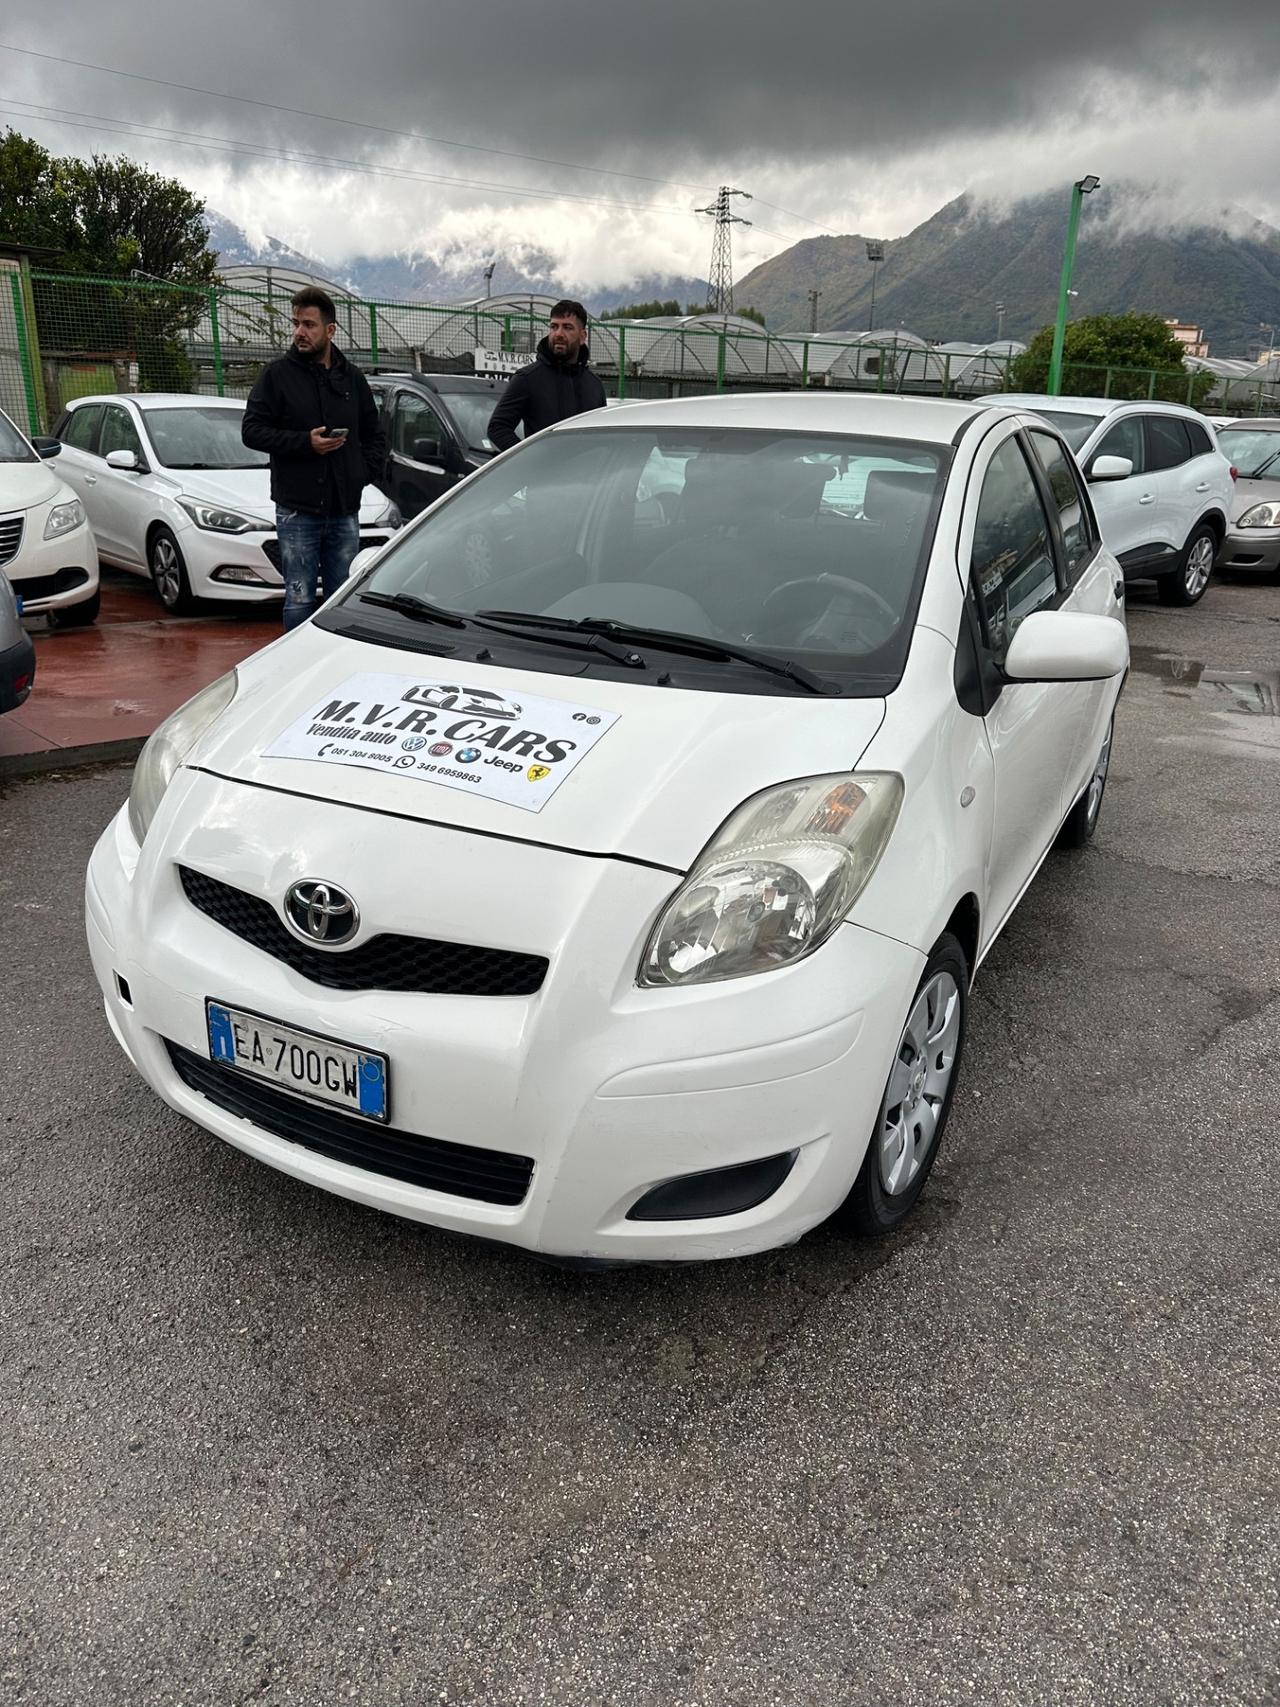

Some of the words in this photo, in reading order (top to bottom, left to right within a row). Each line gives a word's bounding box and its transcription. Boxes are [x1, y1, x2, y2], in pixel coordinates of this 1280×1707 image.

[306, 723, 361, 740] Vendita
[360, 730, 397, 745] auto
[417, 763, 437, 772] 349
[436, 767, 482, 784] 6959863
[484, 756, 523, 773] Jeep
